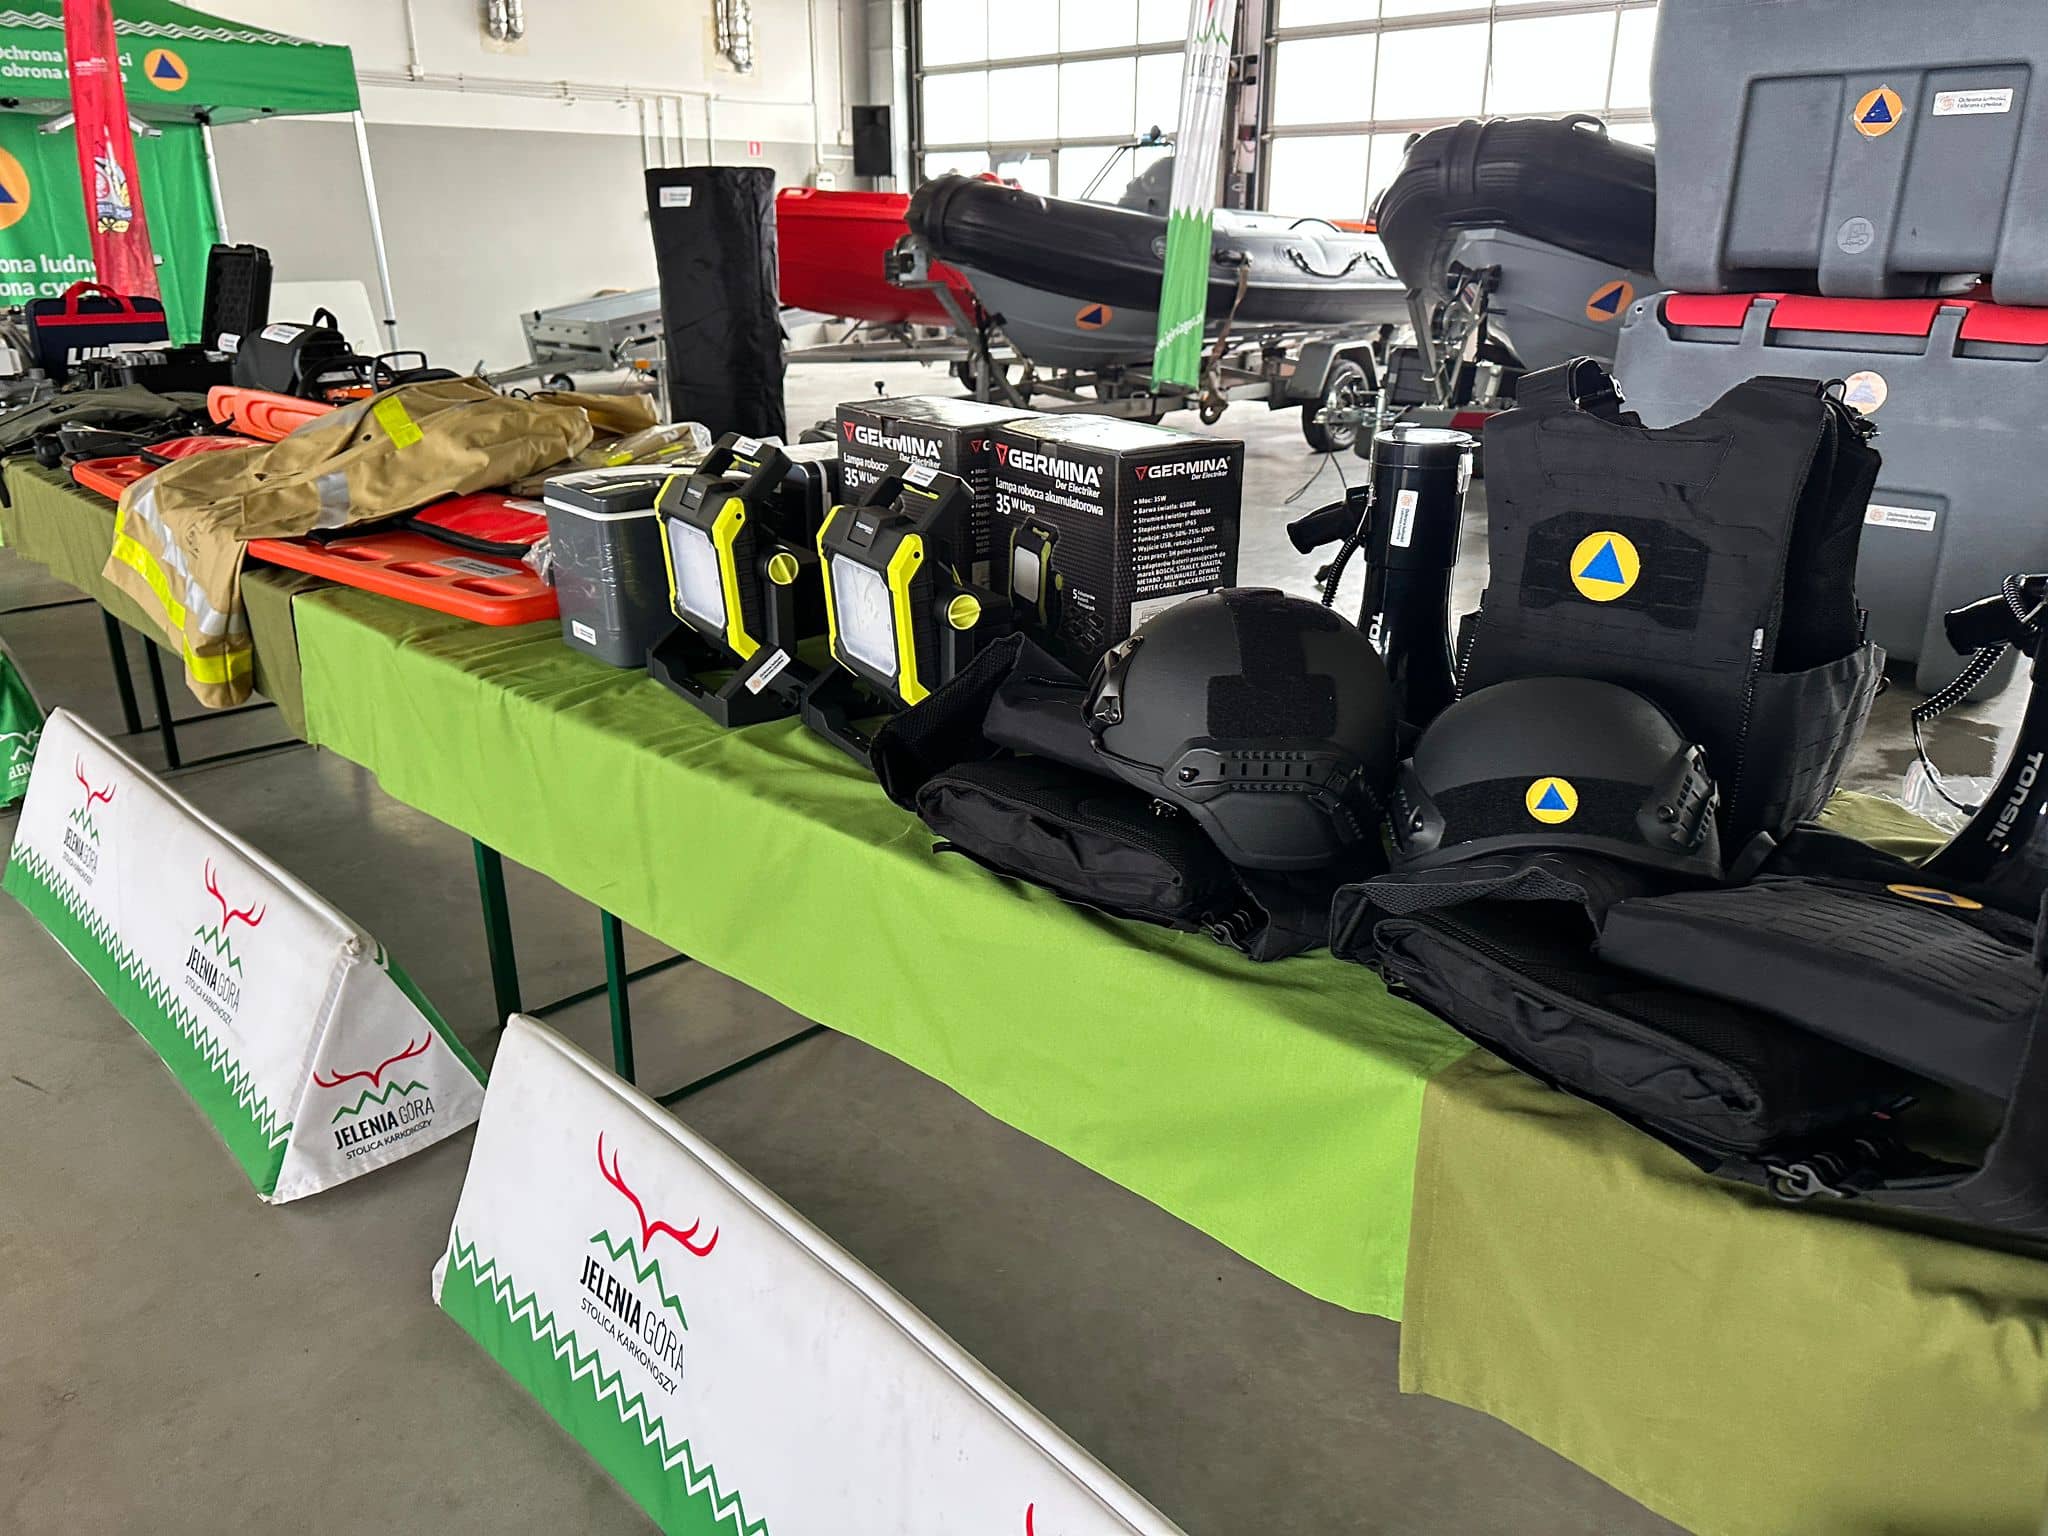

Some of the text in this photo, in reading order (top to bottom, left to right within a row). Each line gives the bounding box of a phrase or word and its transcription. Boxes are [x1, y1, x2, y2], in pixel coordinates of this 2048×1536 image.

[1, 62, 63, 80] obrona
[843, 452, 864, 468] Lampa
[844, 467, 859, 488] 35
[858, 470, 867, 482] W
[1055, 479, 1100, 499] Der Electriker
[1191, 472, 1201, 480] Der
[995, 476, 1104, 516] Lampa robocza akumulatorowa
[995, 493, 1036, 515] 35 W Ursa
[186, 944, 240, 1013] JELENIA GÓRA
[334, 1096, 435, 1150] JELENIA GÓRA
[346, 1119, 432, 1160] STOLICA KARKONOSZY
[580, 1255, 684, 1379] JELENIA GÓRA
[581, 1297, 677, 1396] STOLICA KARKONOSZY
